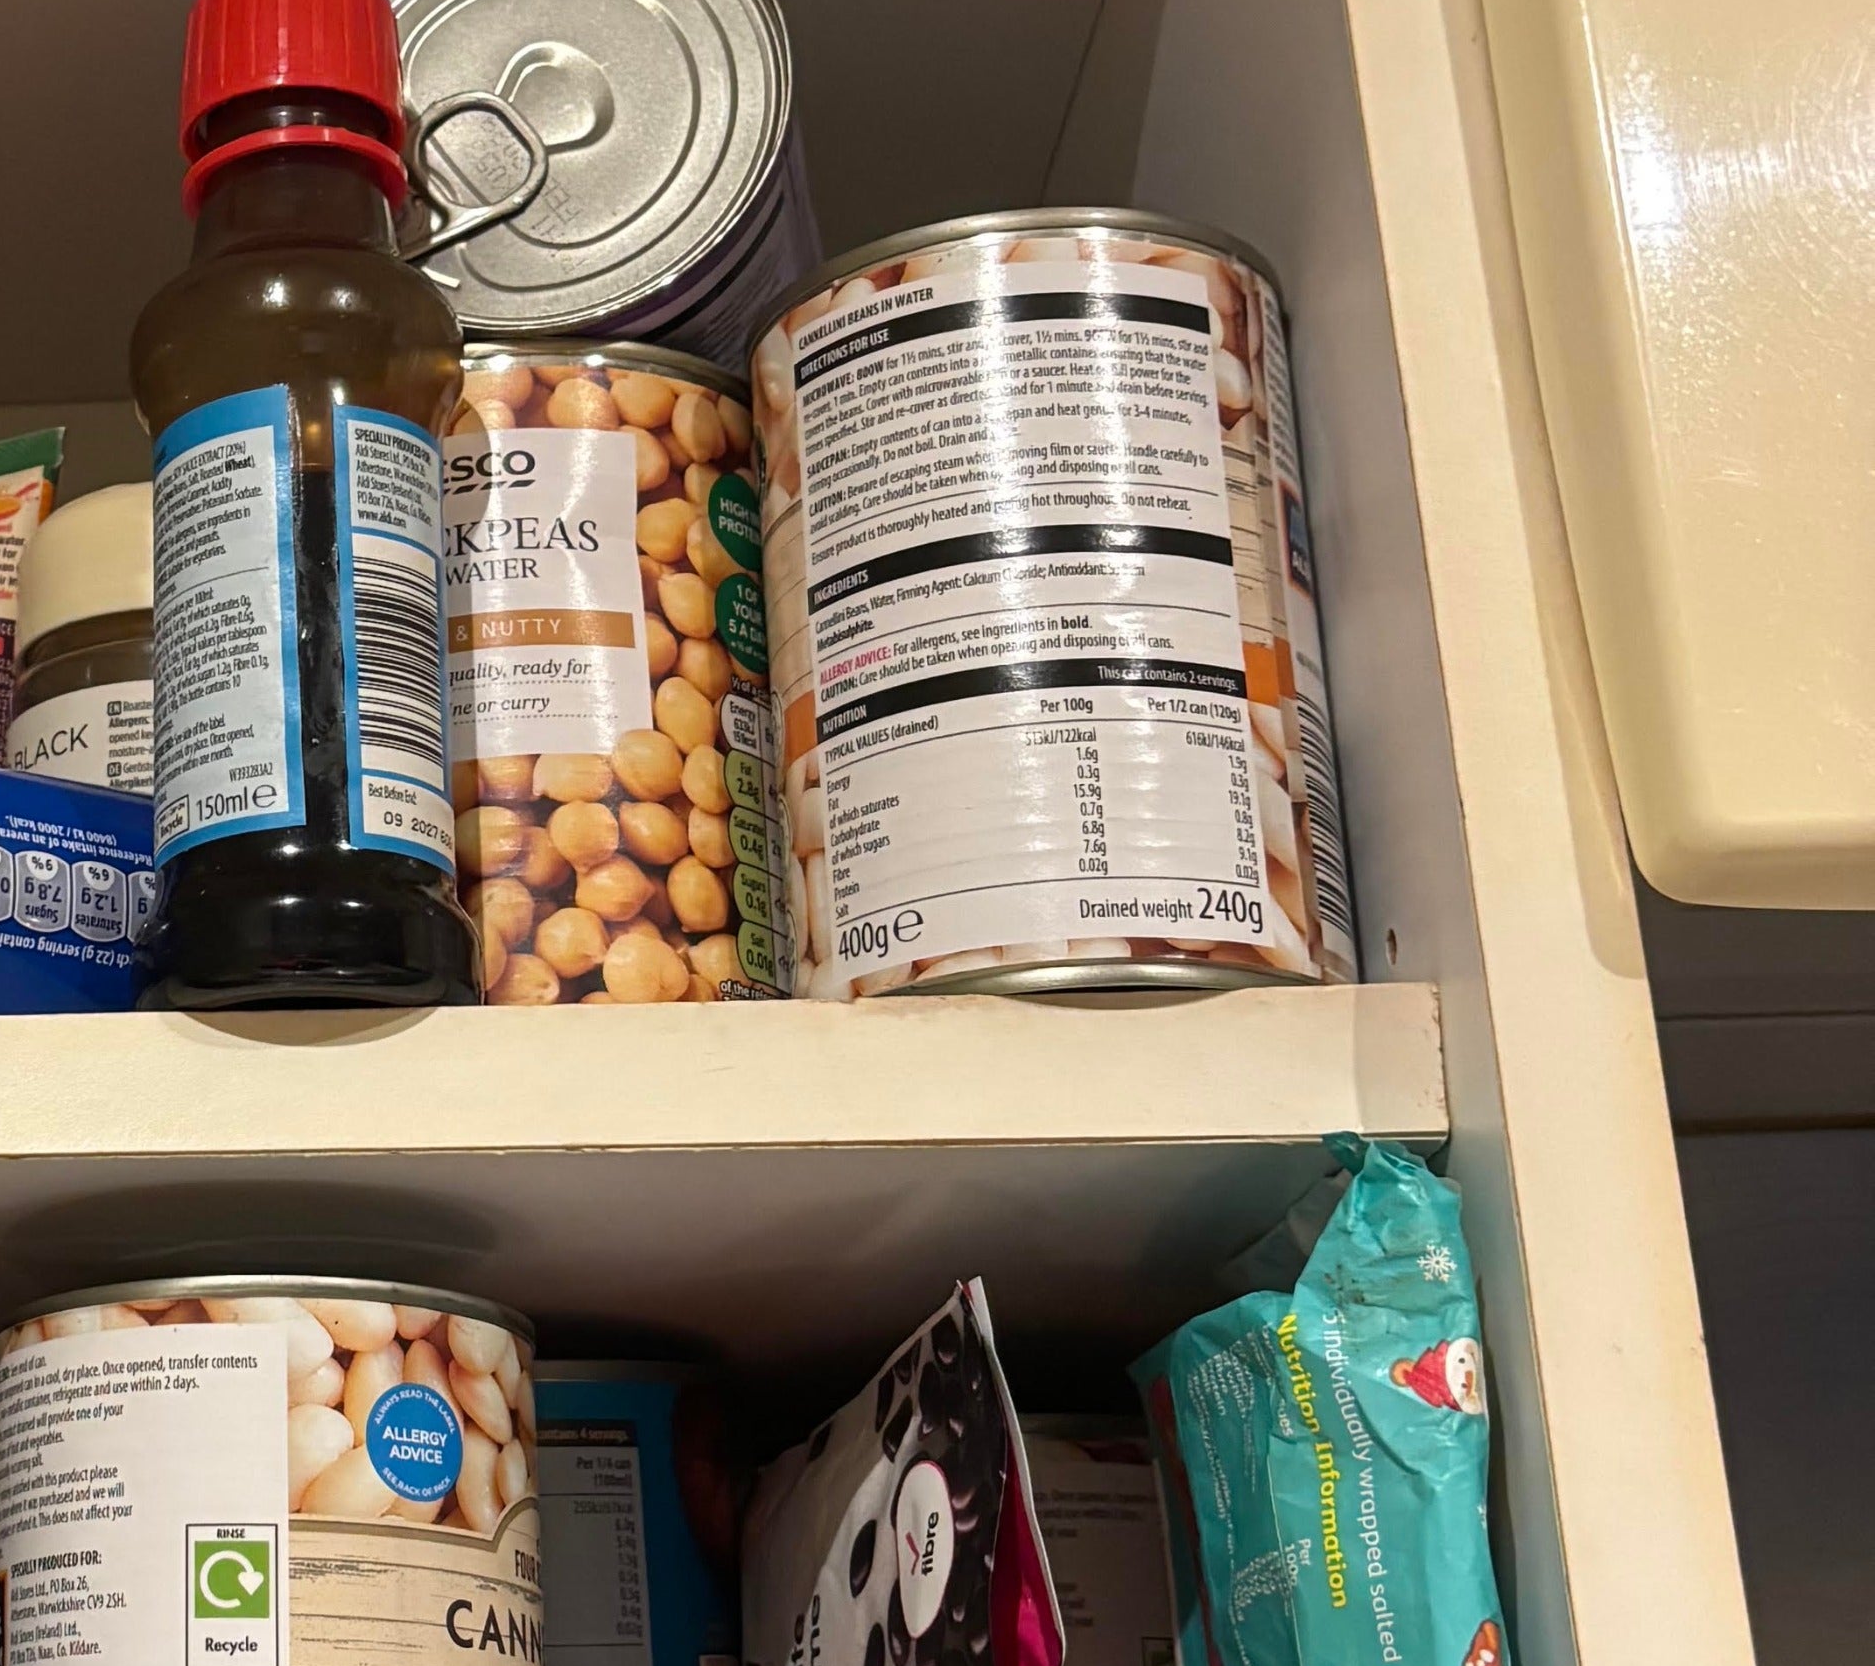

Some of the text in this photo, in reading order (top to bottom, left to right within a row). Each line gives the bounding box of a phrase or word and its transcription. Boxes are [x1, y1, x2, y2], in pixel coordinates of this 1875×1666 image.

[799, 287, 933, 350] CANNELLINI BEANS IN WATER
[443, 450, 536, 482] SCO
[456, 619, 561, 641] & NUTTY
[513, 659, 561, 677] ready
[566, 658, 591, 677] for
[477, 697, 549, 713] or curry
[1040, 698, 1093, 716] Per 100g
[1148, 697, 1241, 723] Per 1/2 can (120g)
[13, 726, 88, 771] BLACK
[195, 793, 248, 823] 150ml
[384, 811, 439, 839] 09 2027
[32, 834, 46, 846] an
[48, 836, 58, 850] of
[61, 839, 96, 858] intake
[98, 845, 153, 866] Reference
[25, 905, 58, 923] Sugars
[1079, 888, 1262, 934] Drained weight 240g
[839, 921, 889, 962] 400g
[382, 1425, 448, 1448] ALLERGY
[389, 1443, 443, 1466] ADVICE
[1276, 1313, 1346, 1609] Nutrition Information
[1325, 1330, 1371, 1466] individually
[1357, 1468, 1385, 1578] wrapped
[1371, 1583, 1396, 1661] salted
[922, 1511, 940, 1578] fibre
[205, 1637, 258, 1654] Recycle
